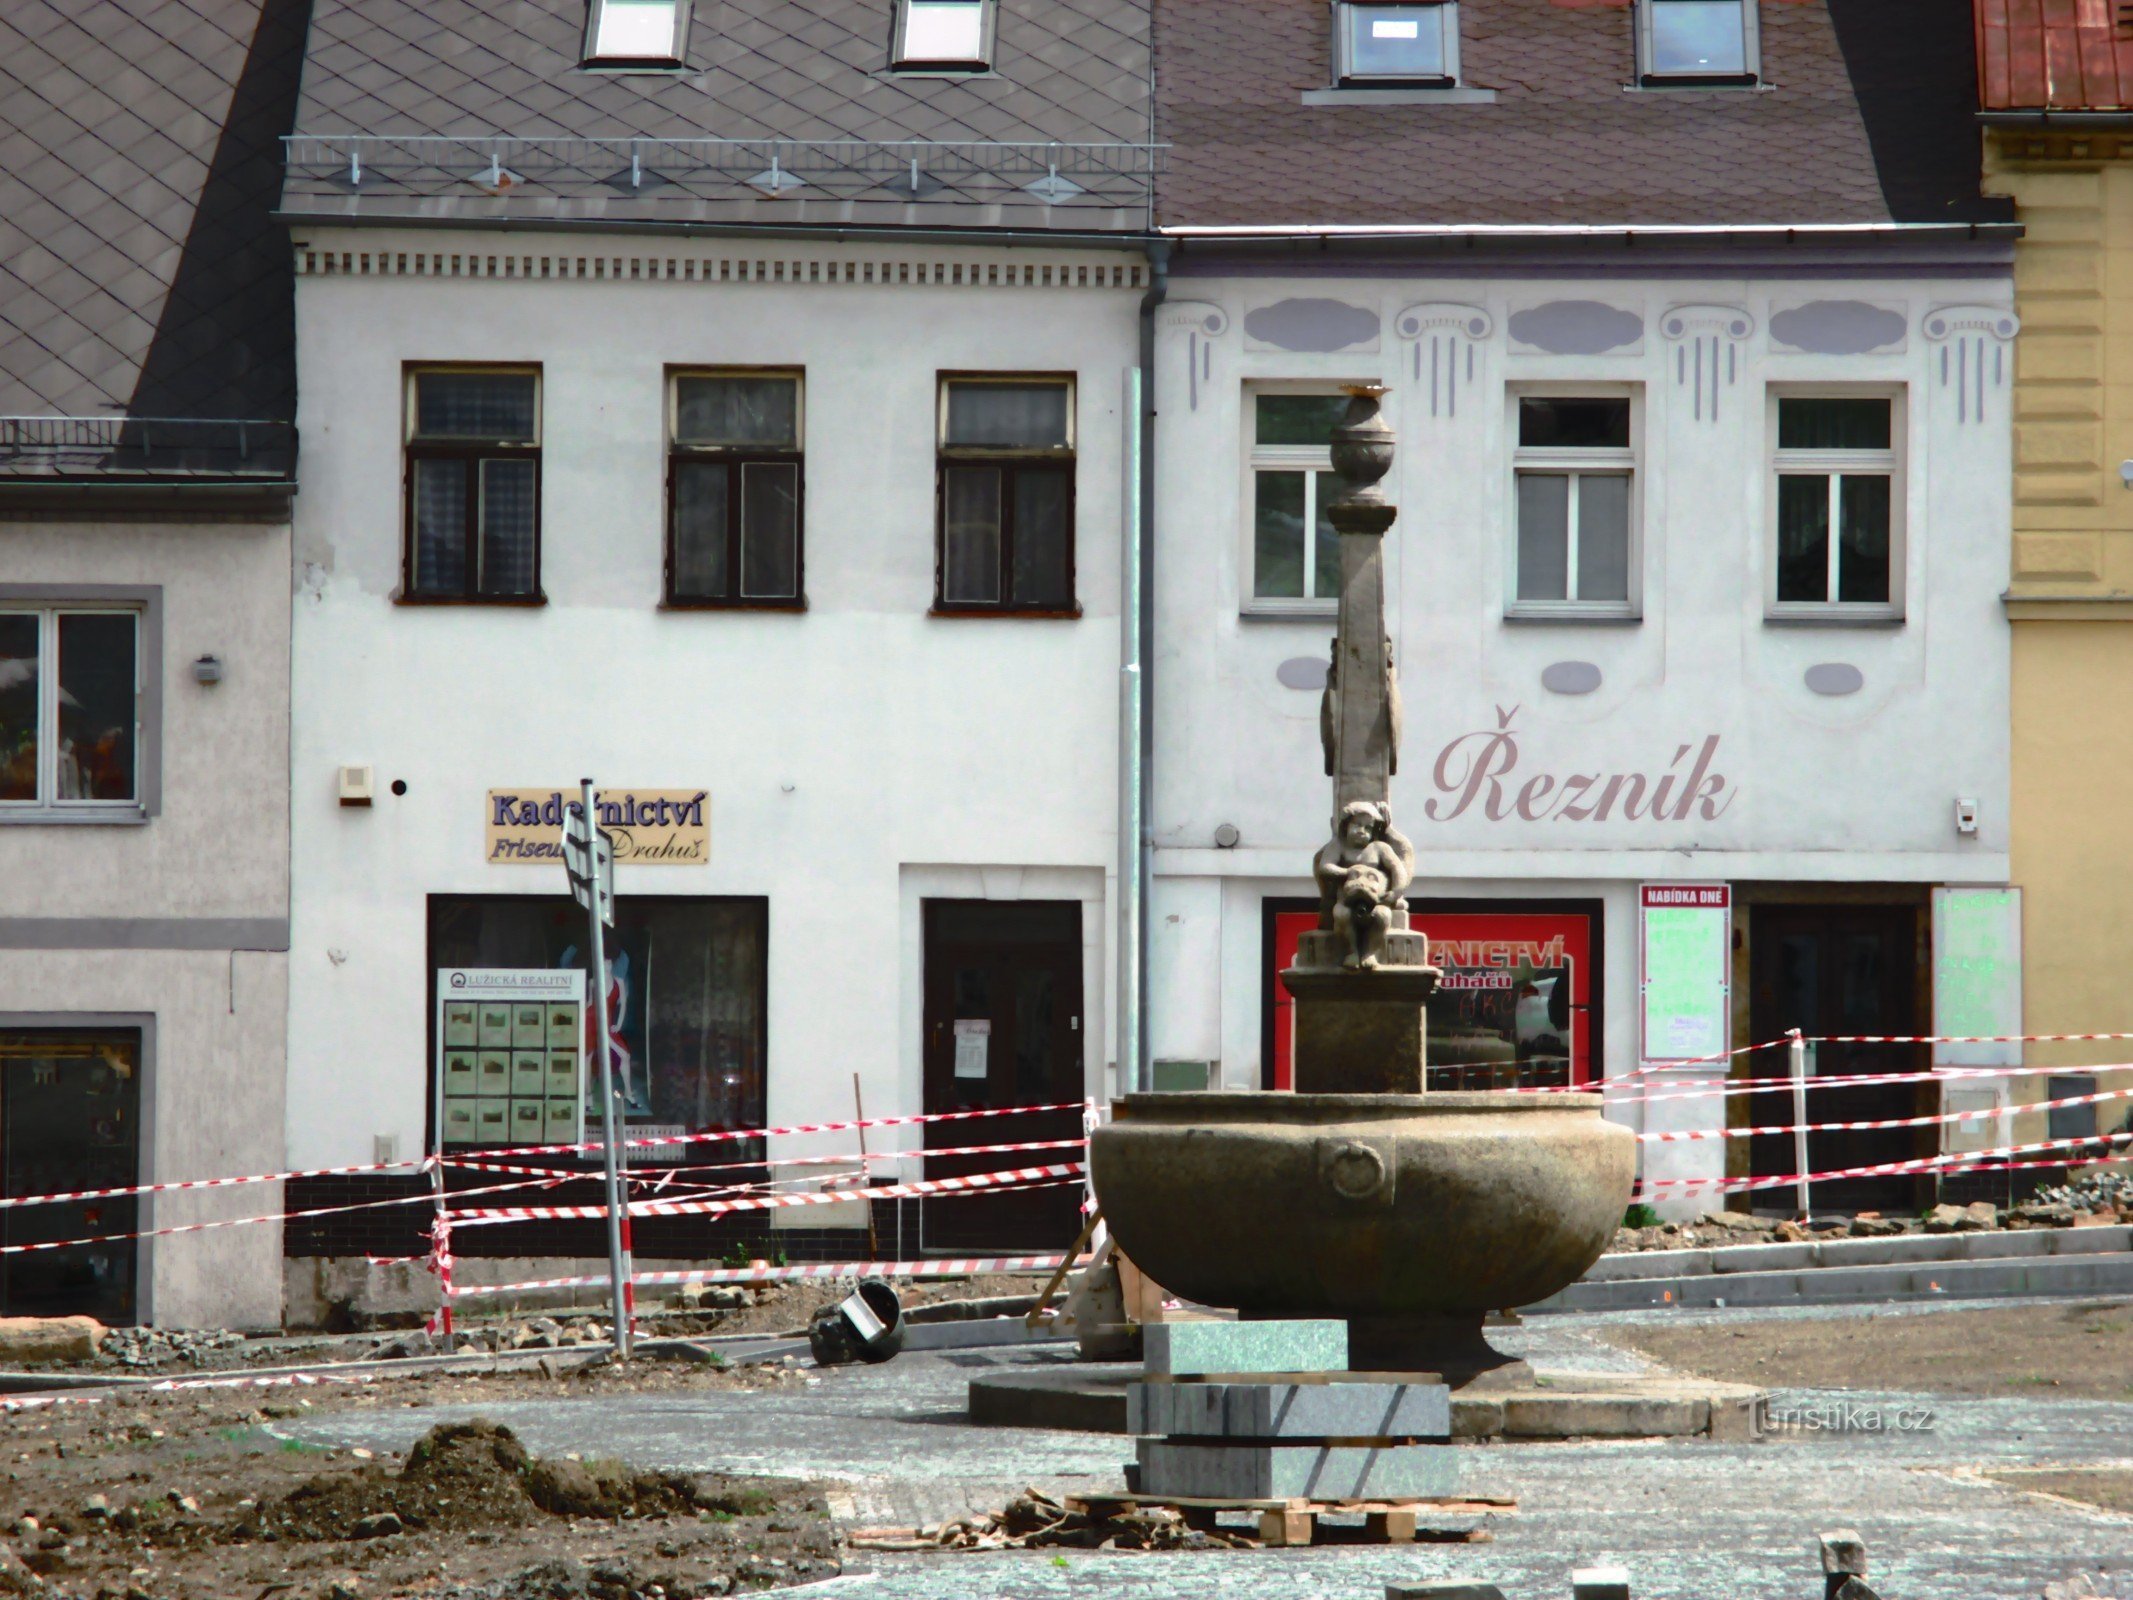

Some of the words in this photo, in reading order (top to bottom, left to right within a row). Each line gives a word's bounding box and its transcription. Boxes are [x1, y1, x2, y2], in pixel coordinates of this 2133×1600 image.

[1424, 704, 1737, 821] Řezník
[492, 791, 706, 827] Kadenictví
[492, 837, 564, 858] Friseu
[1647, 888, 1697, 904] NABÍDKA
[1428, 934, 1565, 969] ZNICTVÍ
[469, 974, 518, 985] LUŽICKÁ
[520, 974, 573, 985] REALITNÍ
[1440, 971, 1513, 989] oháčů
